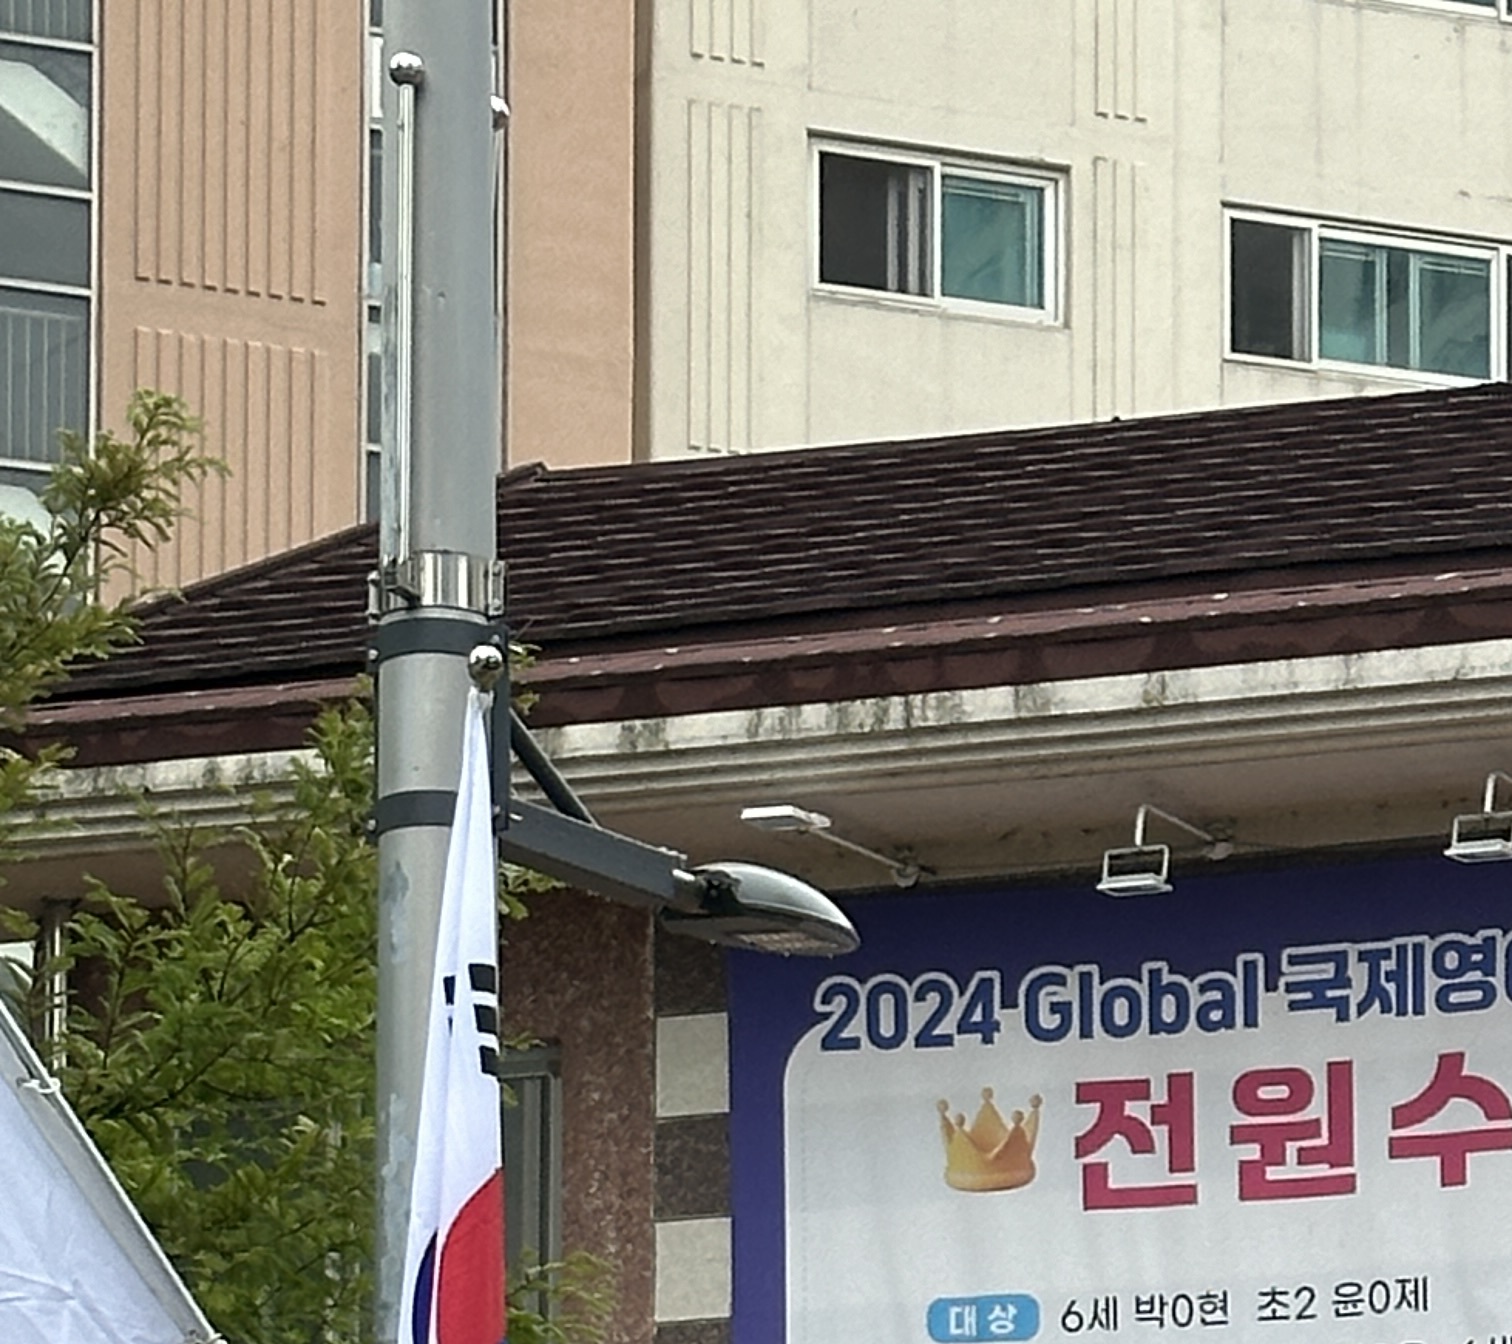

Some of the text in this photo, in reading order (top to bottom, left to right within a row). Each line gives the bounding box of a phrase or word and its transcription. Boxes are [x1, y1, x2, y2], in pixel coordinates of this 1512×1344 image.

[818, 974, 1001, 1054] 2024
[1019, 953, 1262, 1044] Global
[946, 1303, 1019, 1339] 대상
[1060, 1295, 1120, 1334] 6세
[1256, 1286, 1319, 1323] 초2
